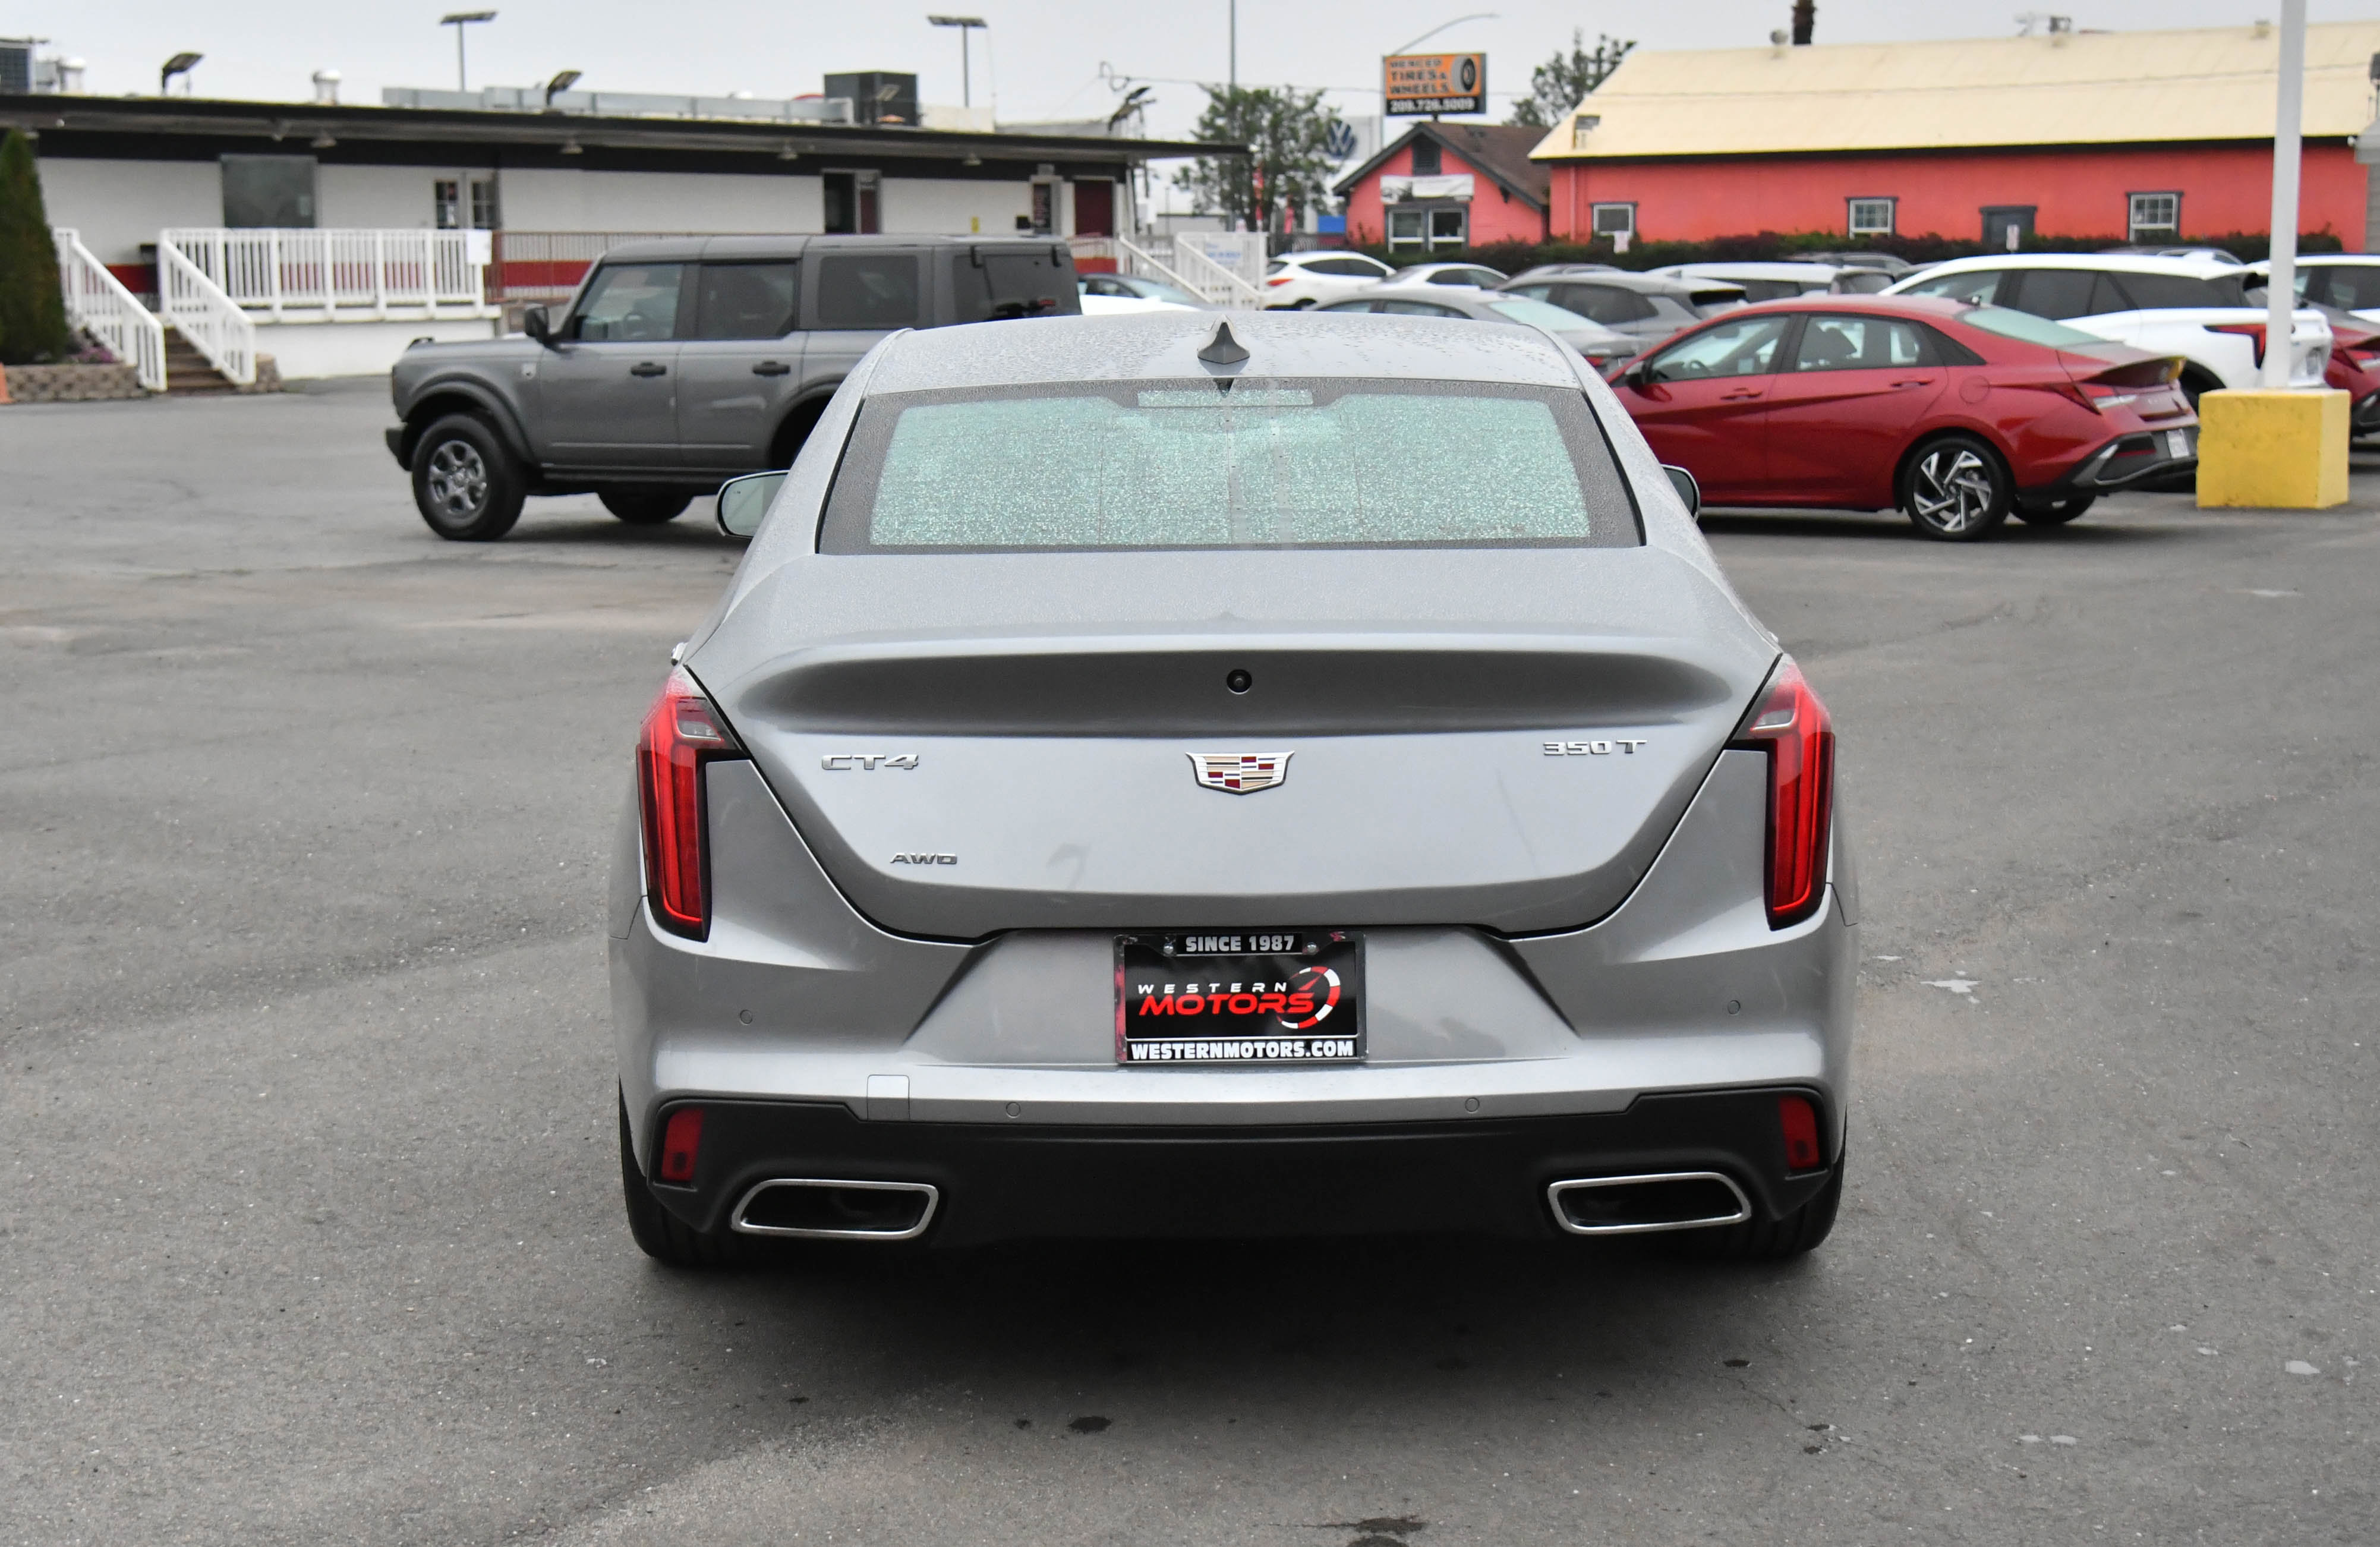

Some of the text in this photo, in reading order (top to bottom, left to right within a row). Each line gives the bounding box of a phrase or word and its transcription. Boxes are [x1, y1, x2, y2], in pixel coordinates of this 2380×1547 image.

[1391, 69, 1437, 81] TIRES
[1389, 82, 1449, 94] WHEELS
[1543, 739, 1648, 756] 350T
[821, 754, 919, 770] CT4
[890, 852, 958, 865] AWD
[1185, 935, 1295, 952] SINCE 1987
[1137, 982, 1288, 994] WESTERN
[1139, 992, 1315, 1016] MOTORS
[1131, 1040, 1354, 1060] WESTERNMOTORS.COM
